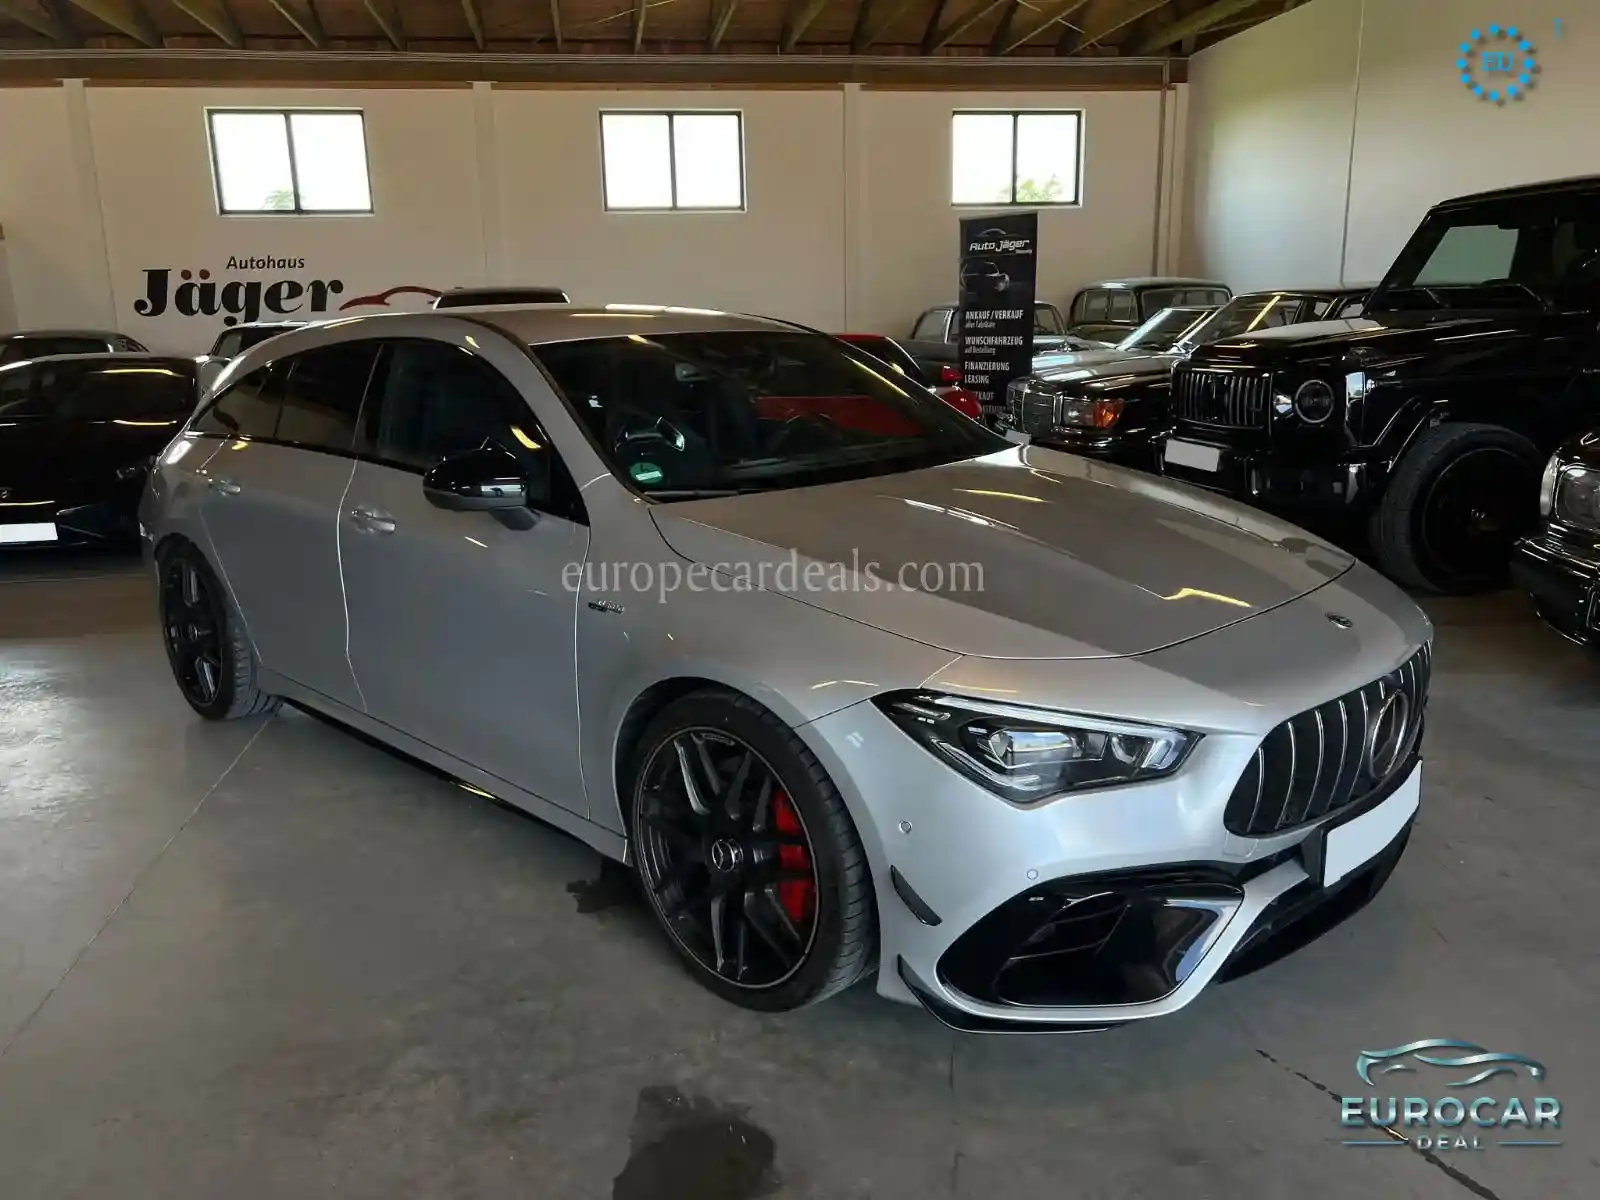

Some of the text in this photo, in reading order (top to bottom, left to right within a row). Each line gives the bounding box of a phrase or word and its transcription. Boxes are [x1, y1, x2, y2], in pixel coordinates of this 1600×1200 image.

[226, 255, 305, 269] Autohaus
[134, 268, 344, 326] Jäger
[965, 309, 1024, 320] ANKAUF/VERKAUF
[964, 335, 1023, 346] WUNSCHFAHRZEUG
[964, 361, 1010, 371] FINANZIERUNG
[964, 374, 990, 384] LEASING
